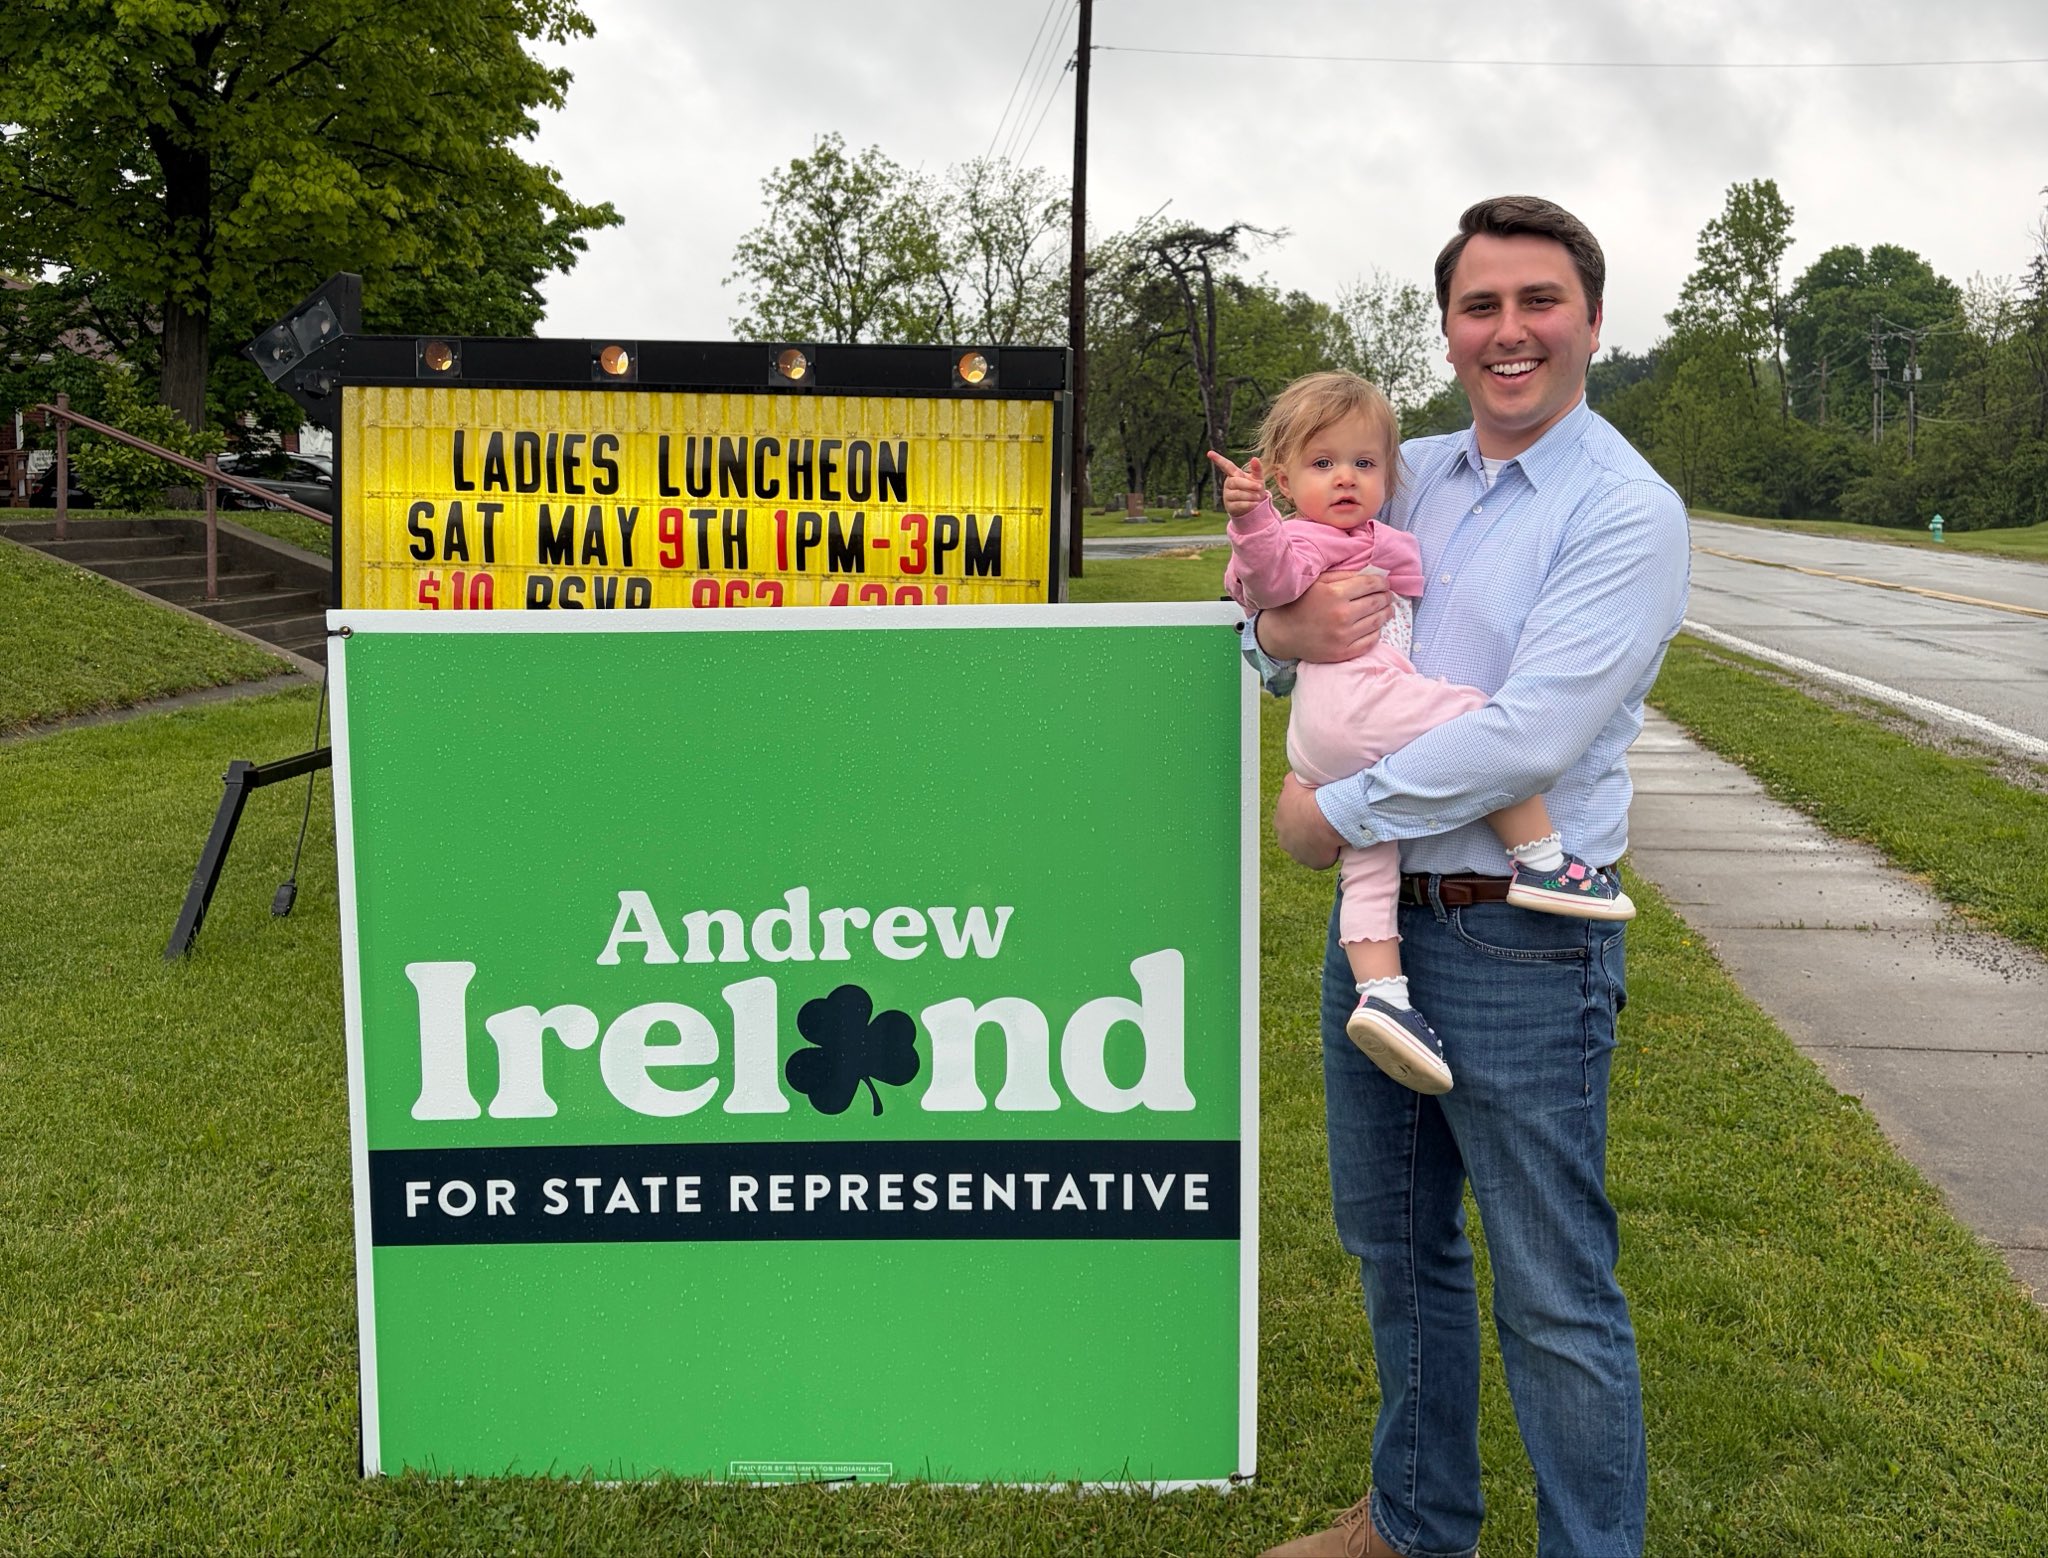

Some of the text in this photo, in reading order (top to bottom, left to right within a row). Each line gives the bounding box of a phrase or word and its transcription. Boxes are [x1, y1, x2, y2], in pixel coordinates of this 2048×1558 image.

[453, 429, 909, 503] LADIES LUNCHEON
[407, 501, 504, 564] SAT
[538, 504, 639, 568] MAY
[659, 508, 749, 570] 9TH
[418, 571, 493, 610] $10
[597, 886, 1014, 966] Andrew
[405, 949, 1196, 1121] Irelnd
[405, 1173, 1209, 1218] FOR STATE REPRESENTATIVE
[835, 1465, 867, 1474] INDIANA
